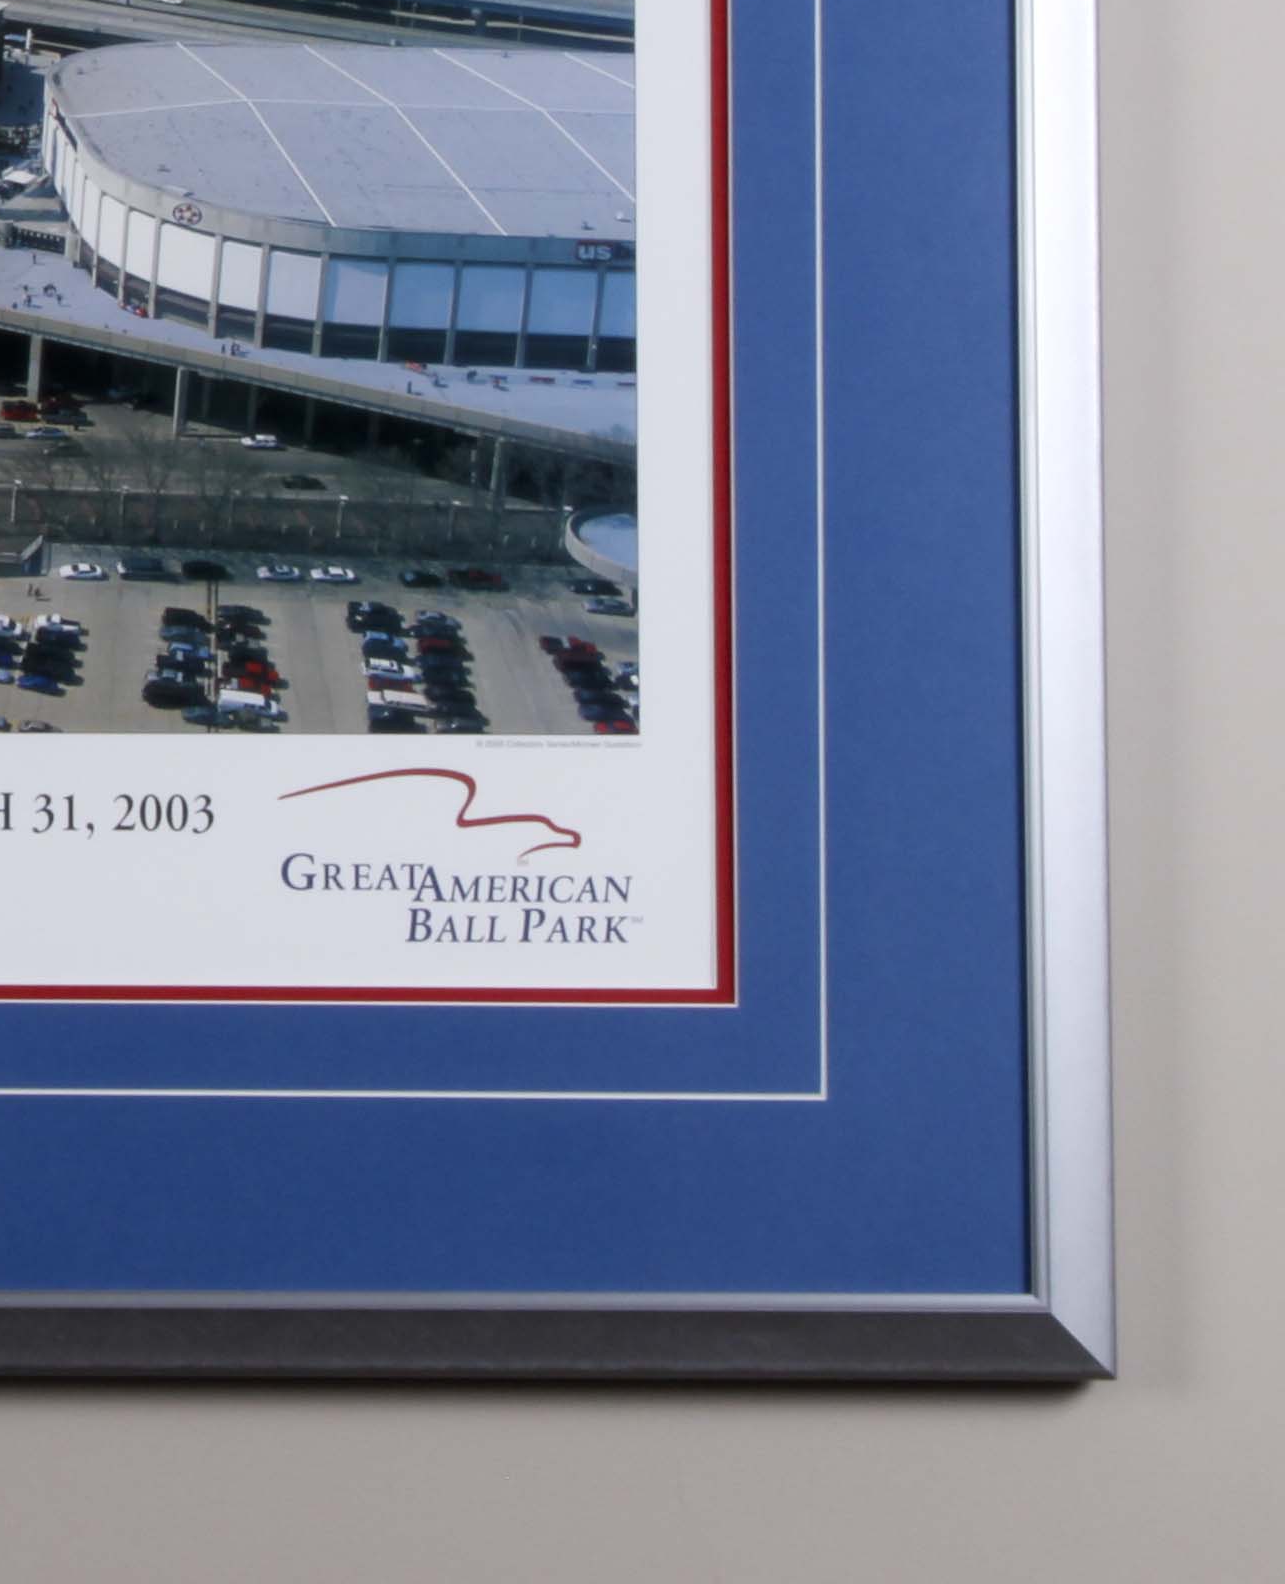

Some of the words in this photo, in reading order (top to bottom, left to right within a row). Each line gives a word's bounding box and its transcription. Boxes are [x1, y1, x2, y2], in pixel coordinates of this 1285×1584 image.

[31, 793, 96, 836] 31,
[112, 793, 216, 834] 2003
[280, 852, 425, 891] GREAT
[412, 865, 633, 904] AMERICAN
[405, 907, 507, 944] BALL
[519, 907, 629, 944] PARK
